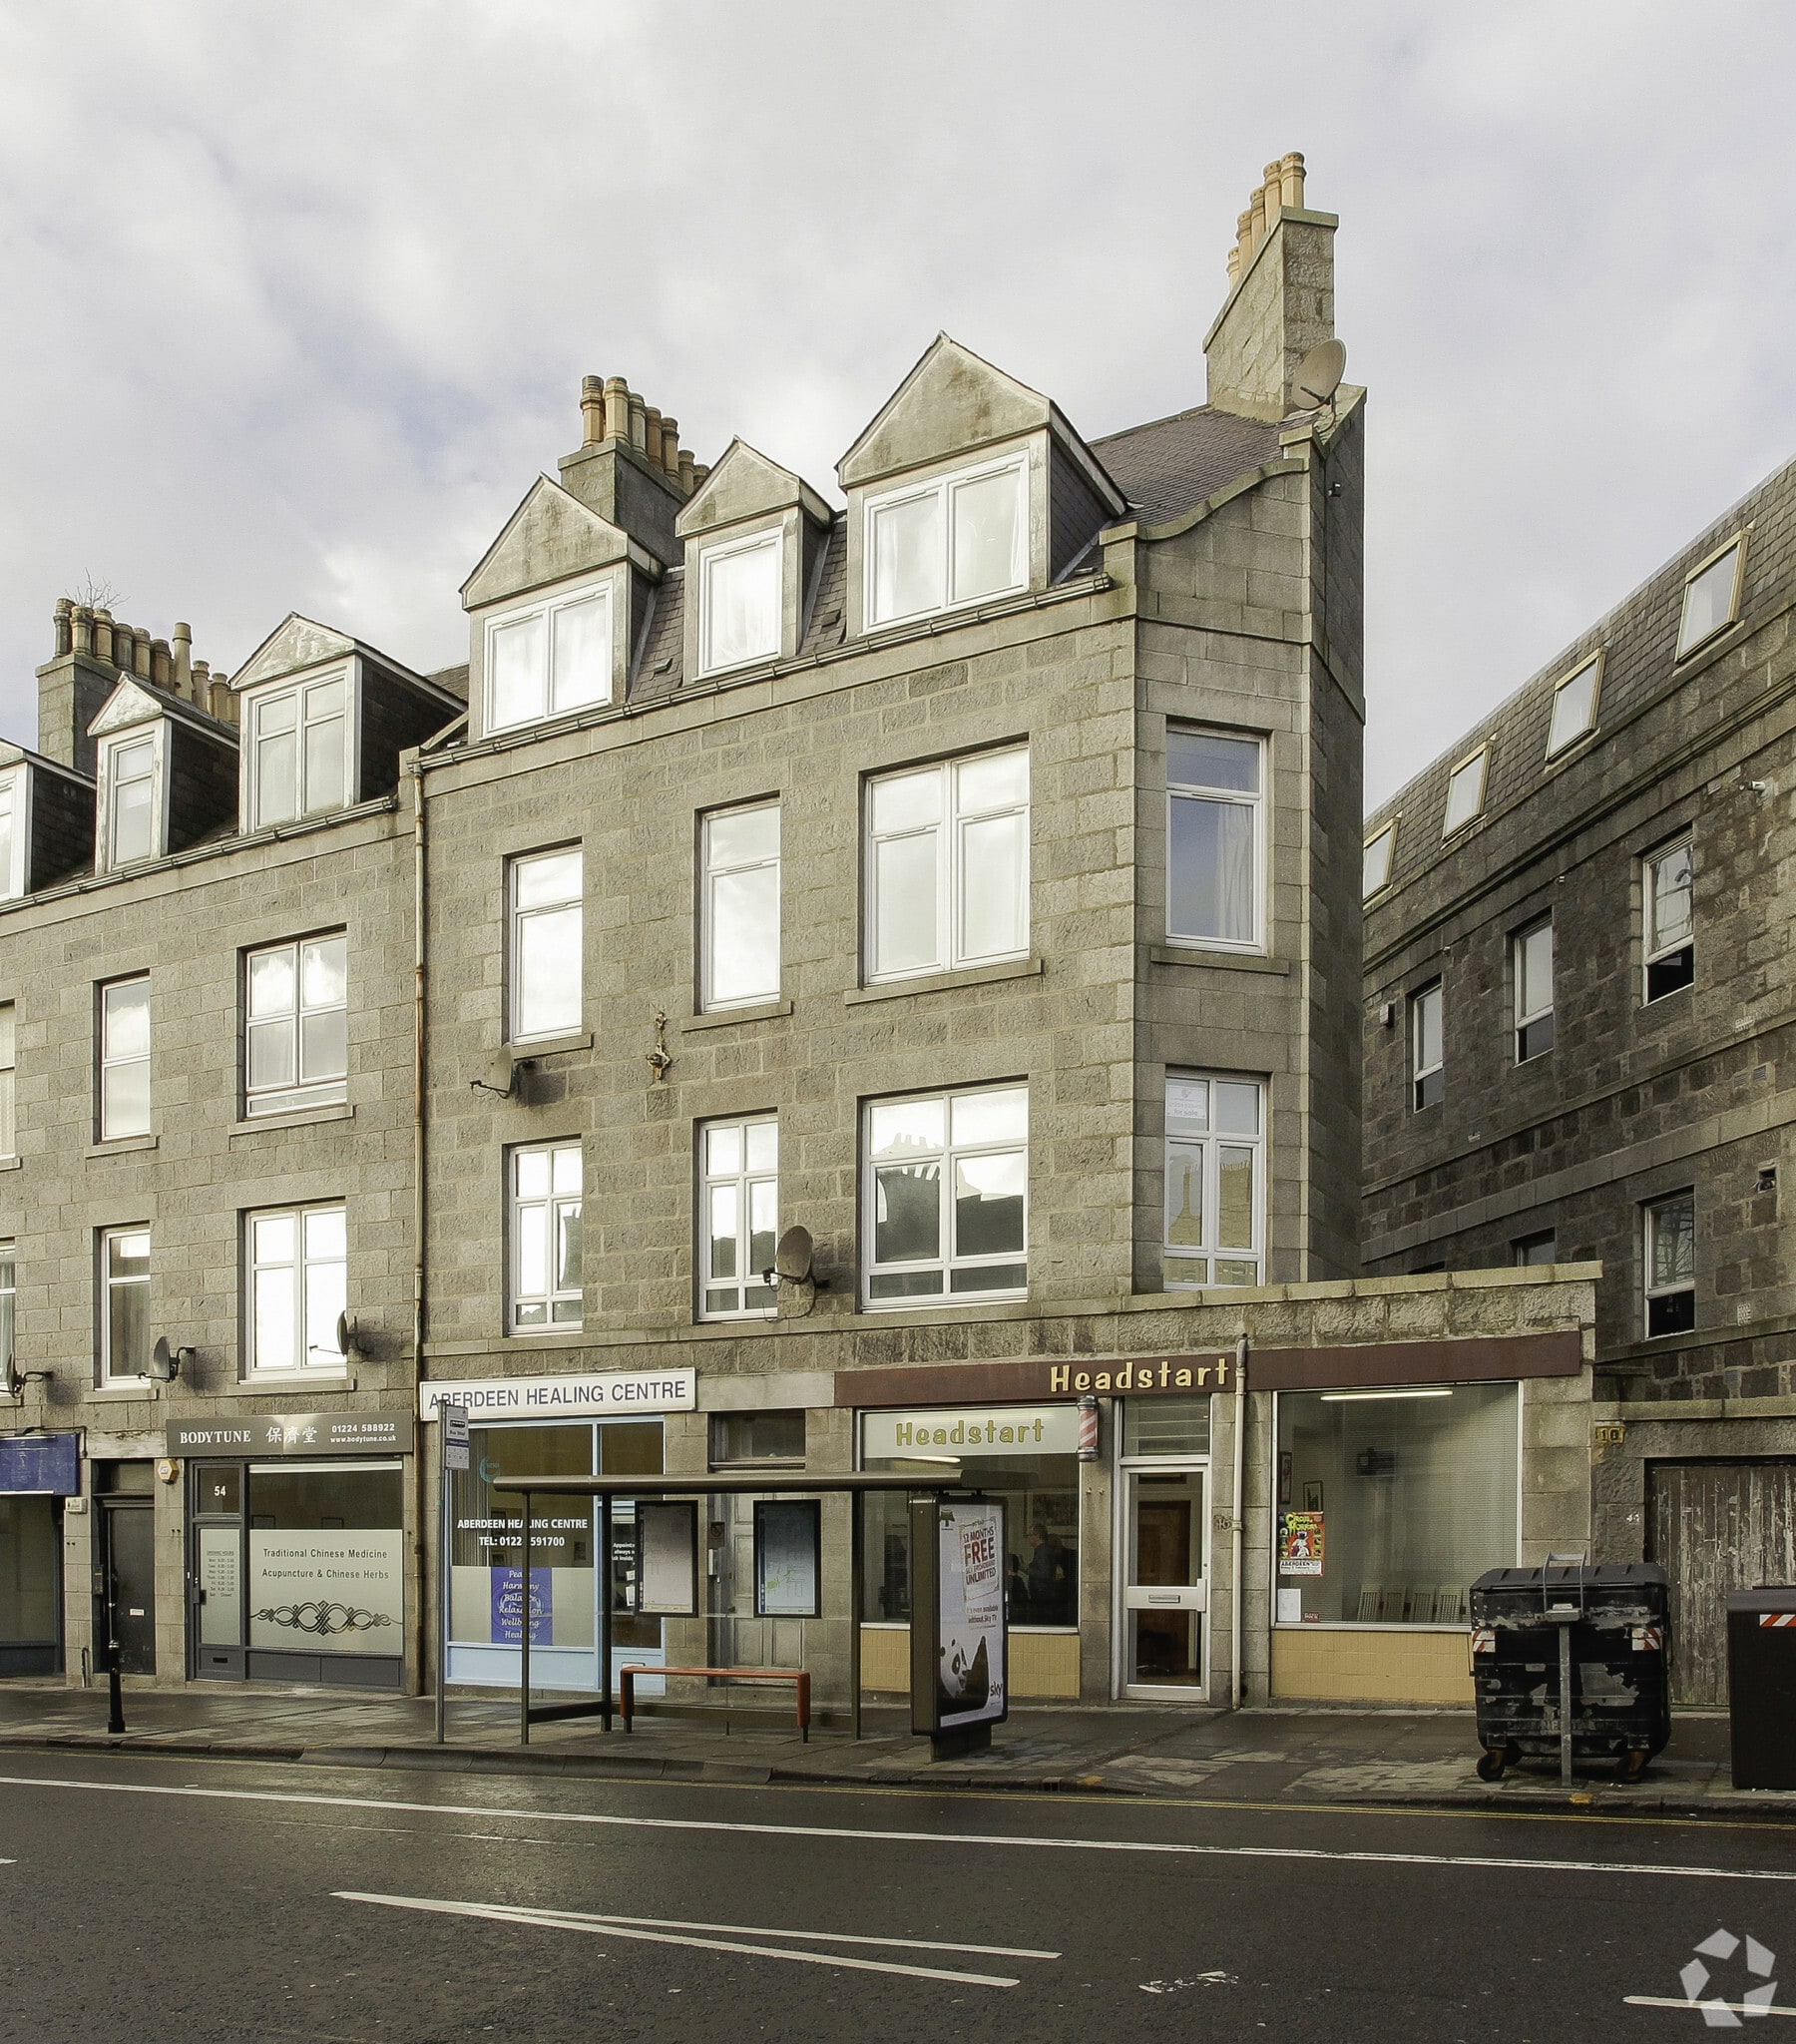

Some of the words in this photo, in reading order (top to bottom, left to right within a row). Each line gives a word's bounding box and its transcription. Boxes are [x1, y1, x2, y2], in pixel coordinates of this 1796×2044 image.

[1050, 1357, 1229, 1392] Headstart
[527, 1384, 604, 1405] HEALING
[612, 1380, 686, 1401] CENTRE
[331, 1423, 357, 1433] 01224
[361, 1422, 395, 1432] 588922
[896, 1418, 1045, 1447] Headstart
[180, 1429, 251, 1444] BODYTUNE
[330, 1434, 397, 1444] www.bodytune.co.uk
[214, 1485, 226, 1496] 54
[457, 1519, 505, 1529] ABERDEEN
[551, 1519, 588, 1529] CENTRE
[479, 1536, 498, 1546] TEL:
[499, 1536, 523, 1546] 0122
[530, 1536, 566, 1547] 591700
[263, 1548, 307, 1558] Traditional
[310, 1549, 345, 1558] Chinese
[348, 1549, 388, 1559] Medicine
[963, 1536, 996, 1567] FREE
[261, 1568, 314, 1579] Acupuncture
[316, 1569, 323, 1578] &
[326, 1569, 360, 1579] Chinese
[363, 1570, 389, 1579] Herbs
[966, 1566, 997, 1586] UNLIMITED
[990, 1681, 1004, 1699] sky
